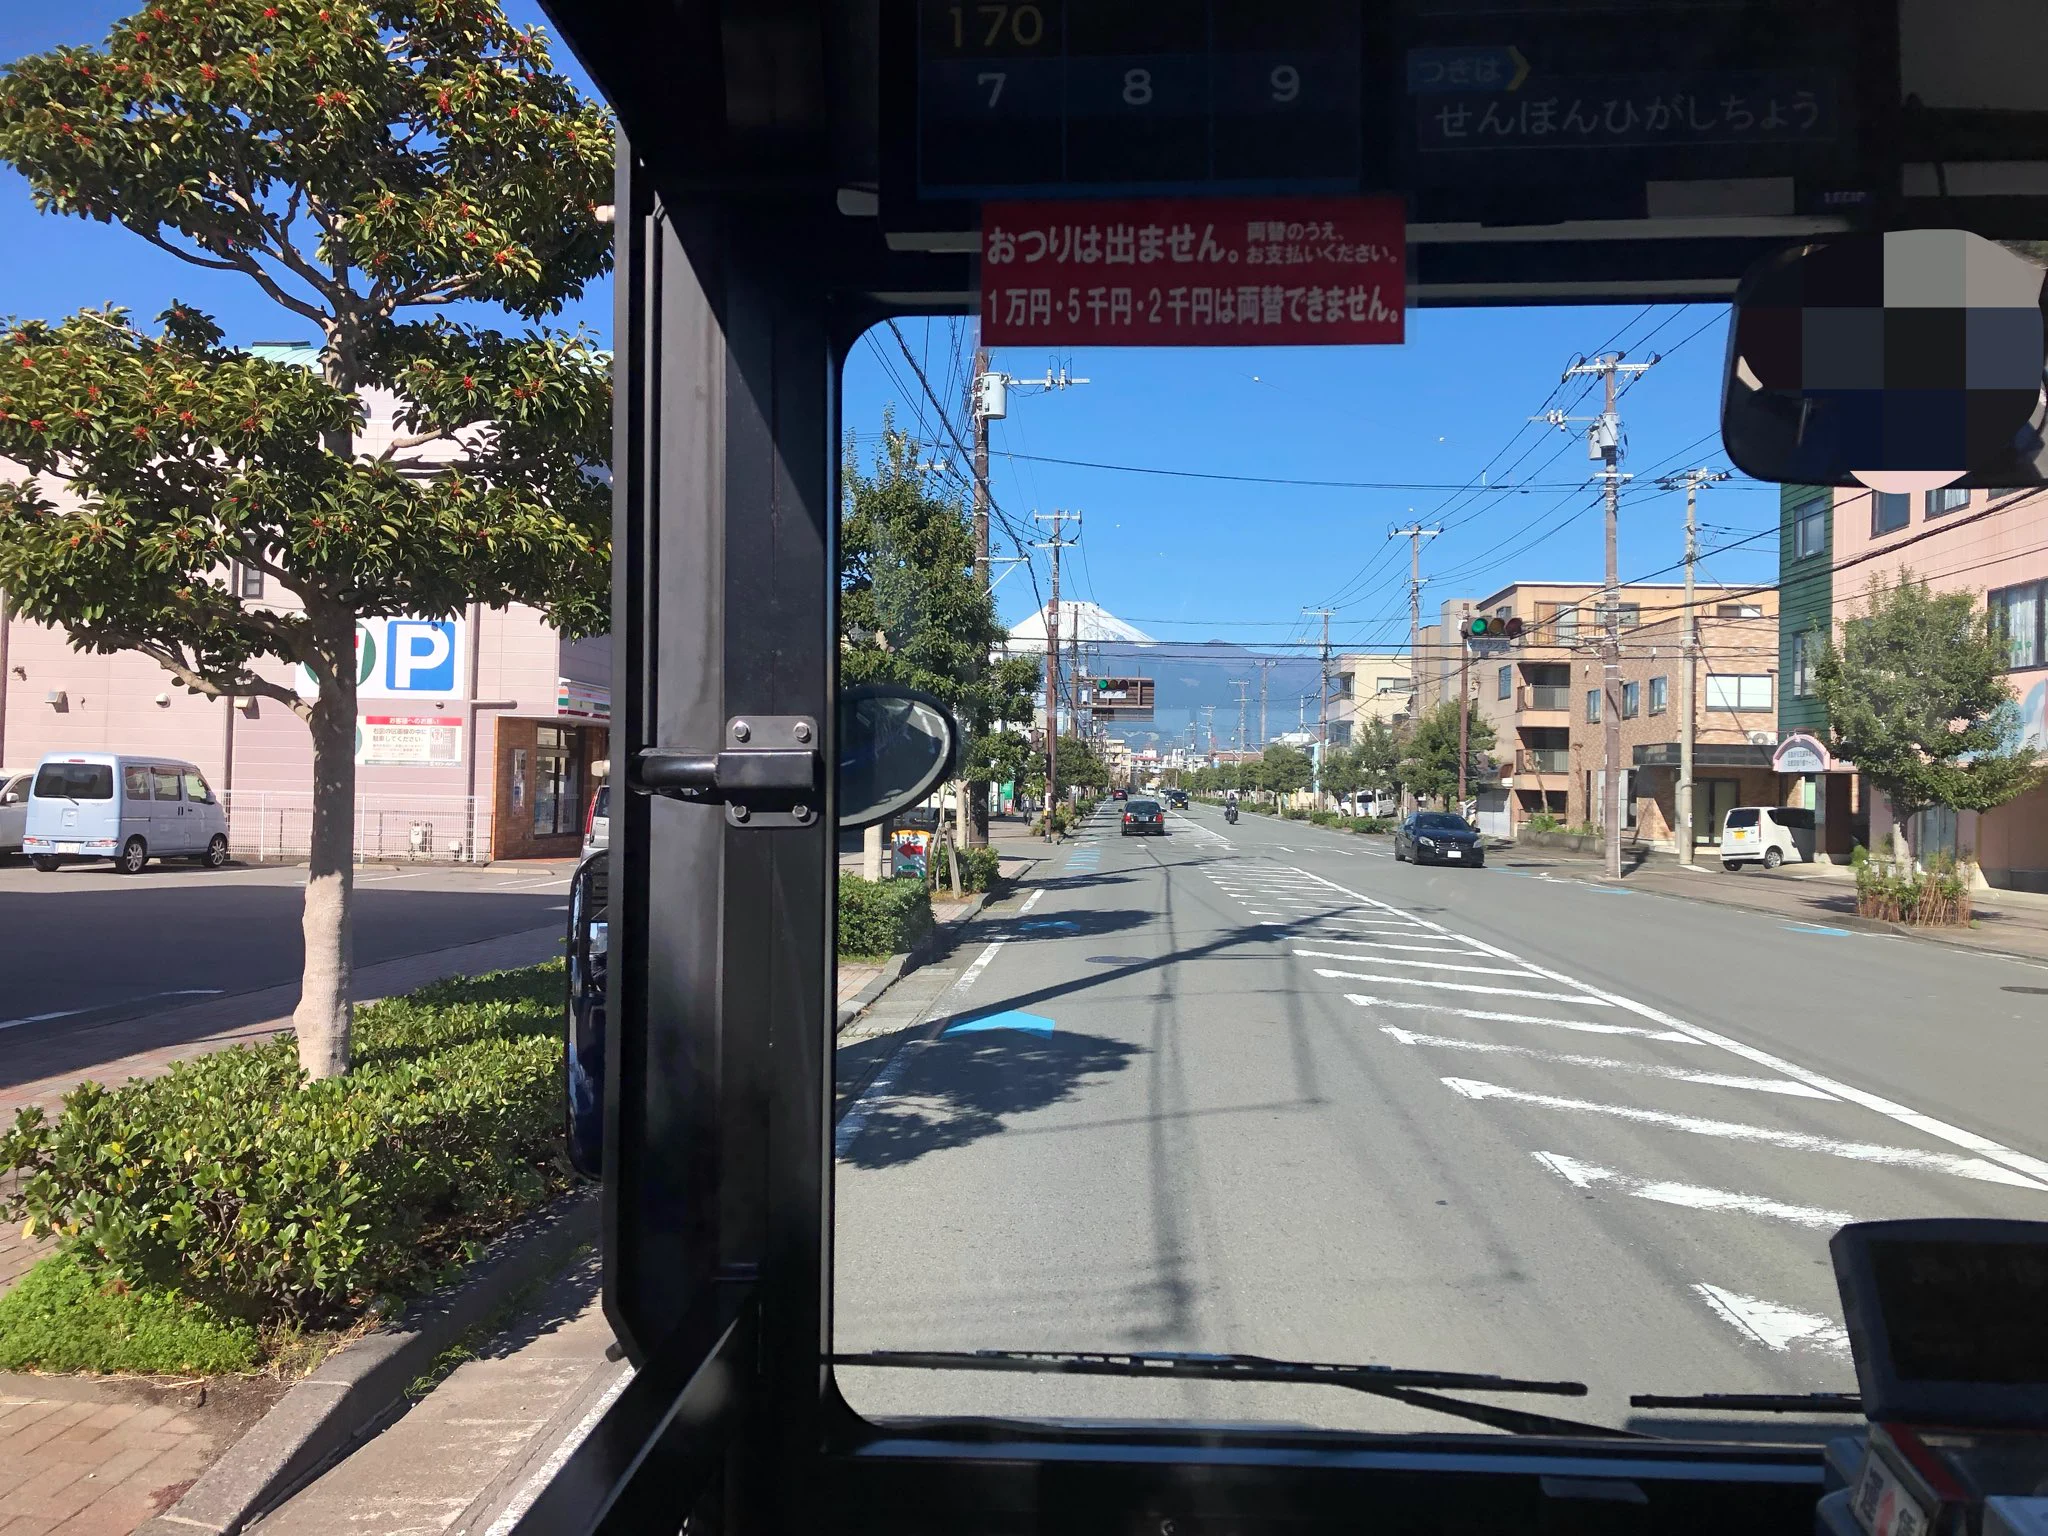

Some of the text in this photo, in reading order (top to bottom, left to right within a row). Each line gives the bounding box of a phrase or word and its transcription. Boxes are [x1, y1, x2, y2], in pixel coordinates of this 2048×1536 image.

[948, 5, 1044, 48] 170
[977, 64, 1300, 109] 7 8 9
[1417, 56, 1501, 84] つぎは
[1435, 90, 1820, 138] せんぼんひがしちょう
[987, 223, 1240, 265] おつりは出ません。
[1247, 221, 1344, 242] 両替のうえ、
[1246, 243, 1398, 265] お支払いください。
[394, 623, 450, 689] P
